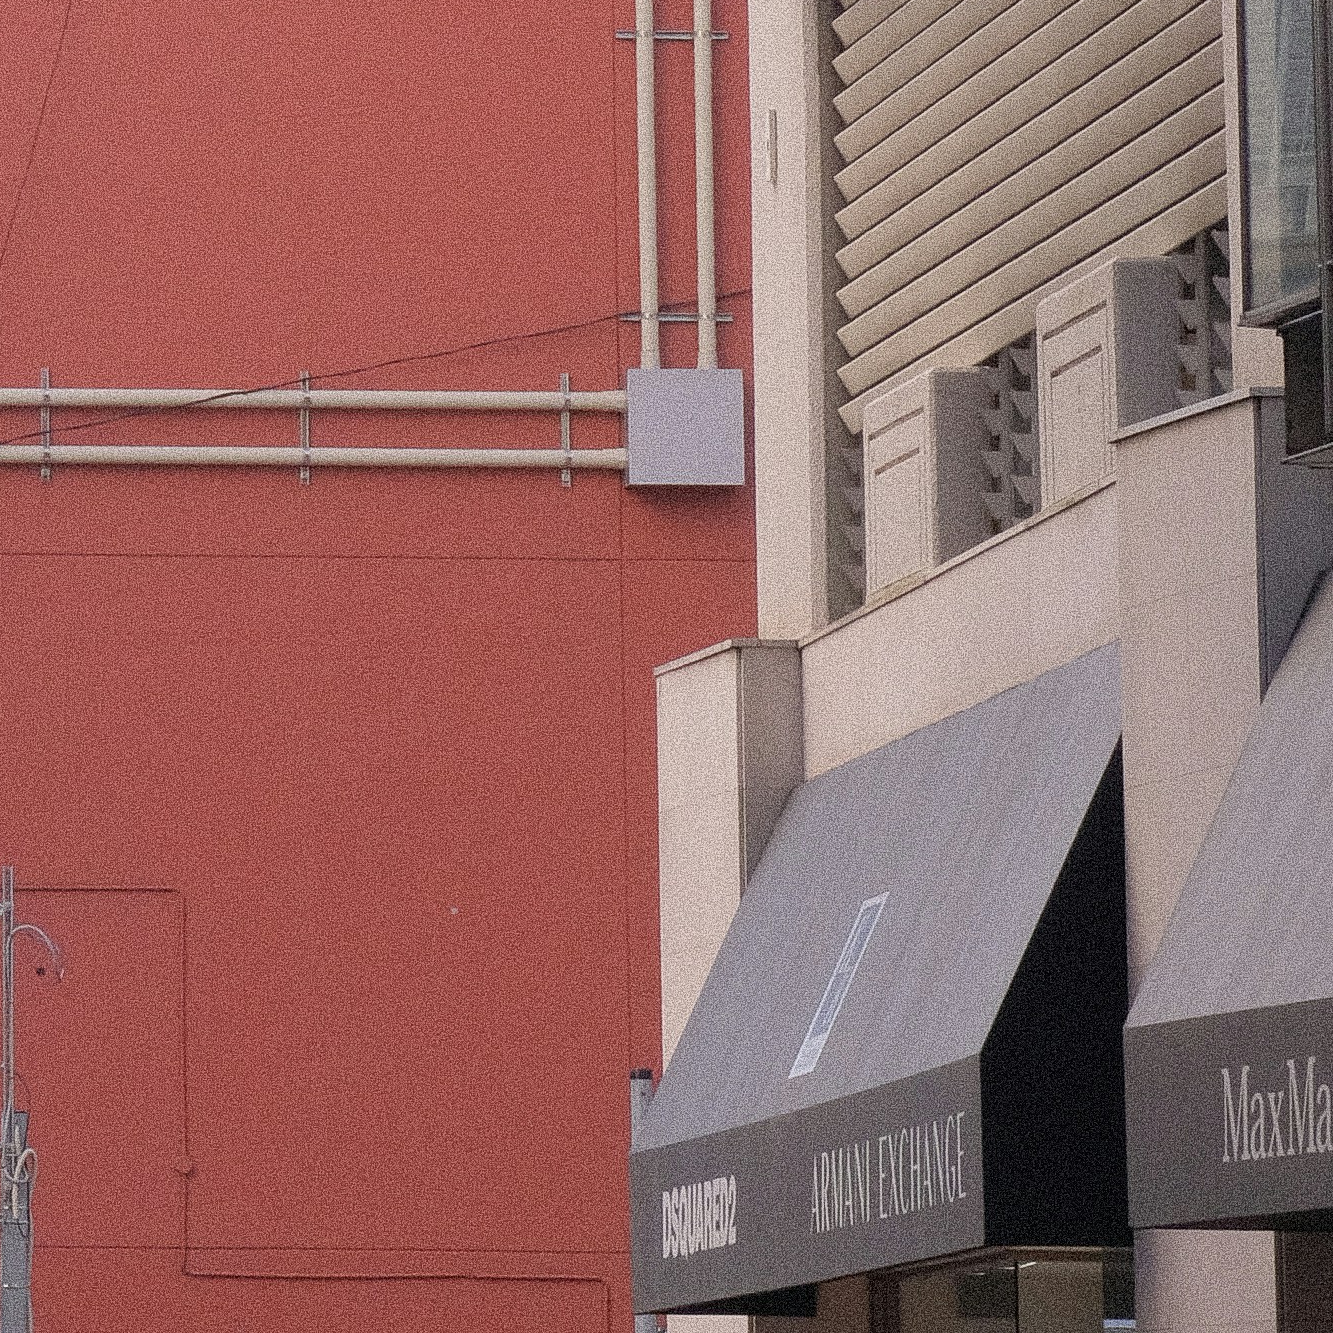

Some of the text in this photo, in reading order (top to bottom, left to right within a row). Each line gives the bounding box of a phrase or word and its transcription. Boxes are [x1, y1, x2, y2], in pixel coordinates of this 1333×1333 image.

[663, 1174, 737, 1260] DSQUARED2
[810, 1111, 967, 1234] ARMANI EXCHANGE
